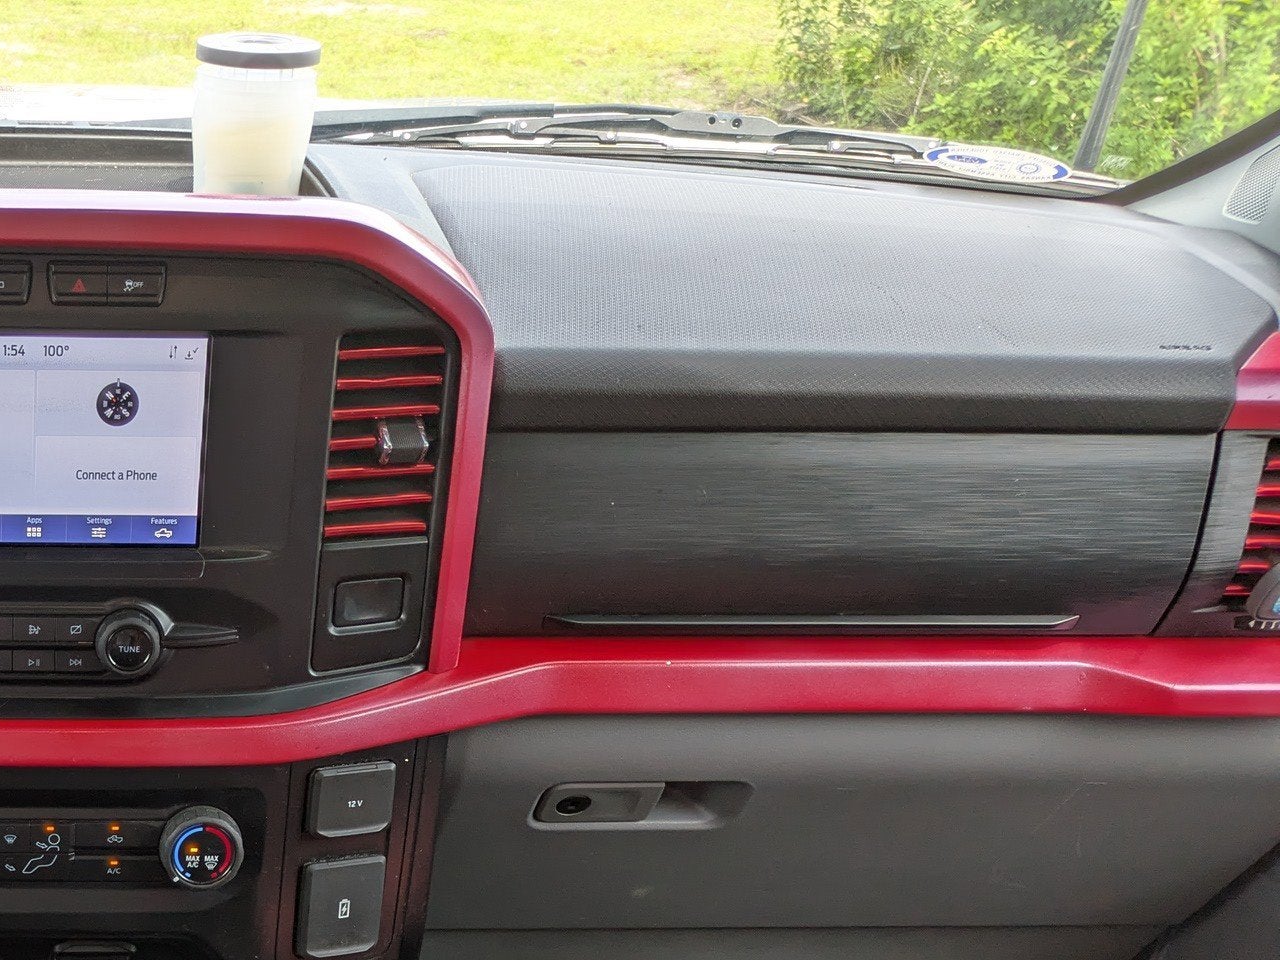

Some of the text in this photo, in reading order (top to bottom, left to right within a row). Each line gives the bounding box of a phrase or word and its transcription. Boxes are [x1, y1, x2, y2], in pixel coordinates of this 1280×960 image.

[3, 344, 70, 357] 1:54 100°
[76, 469, 158, 481] Connect a Phone
[26, 516, 43, 525] Apps
[86, 516, 112, 525] Settings
[150, 517, 178, 525] Features
[118, 645, 140, 653] TUNE
